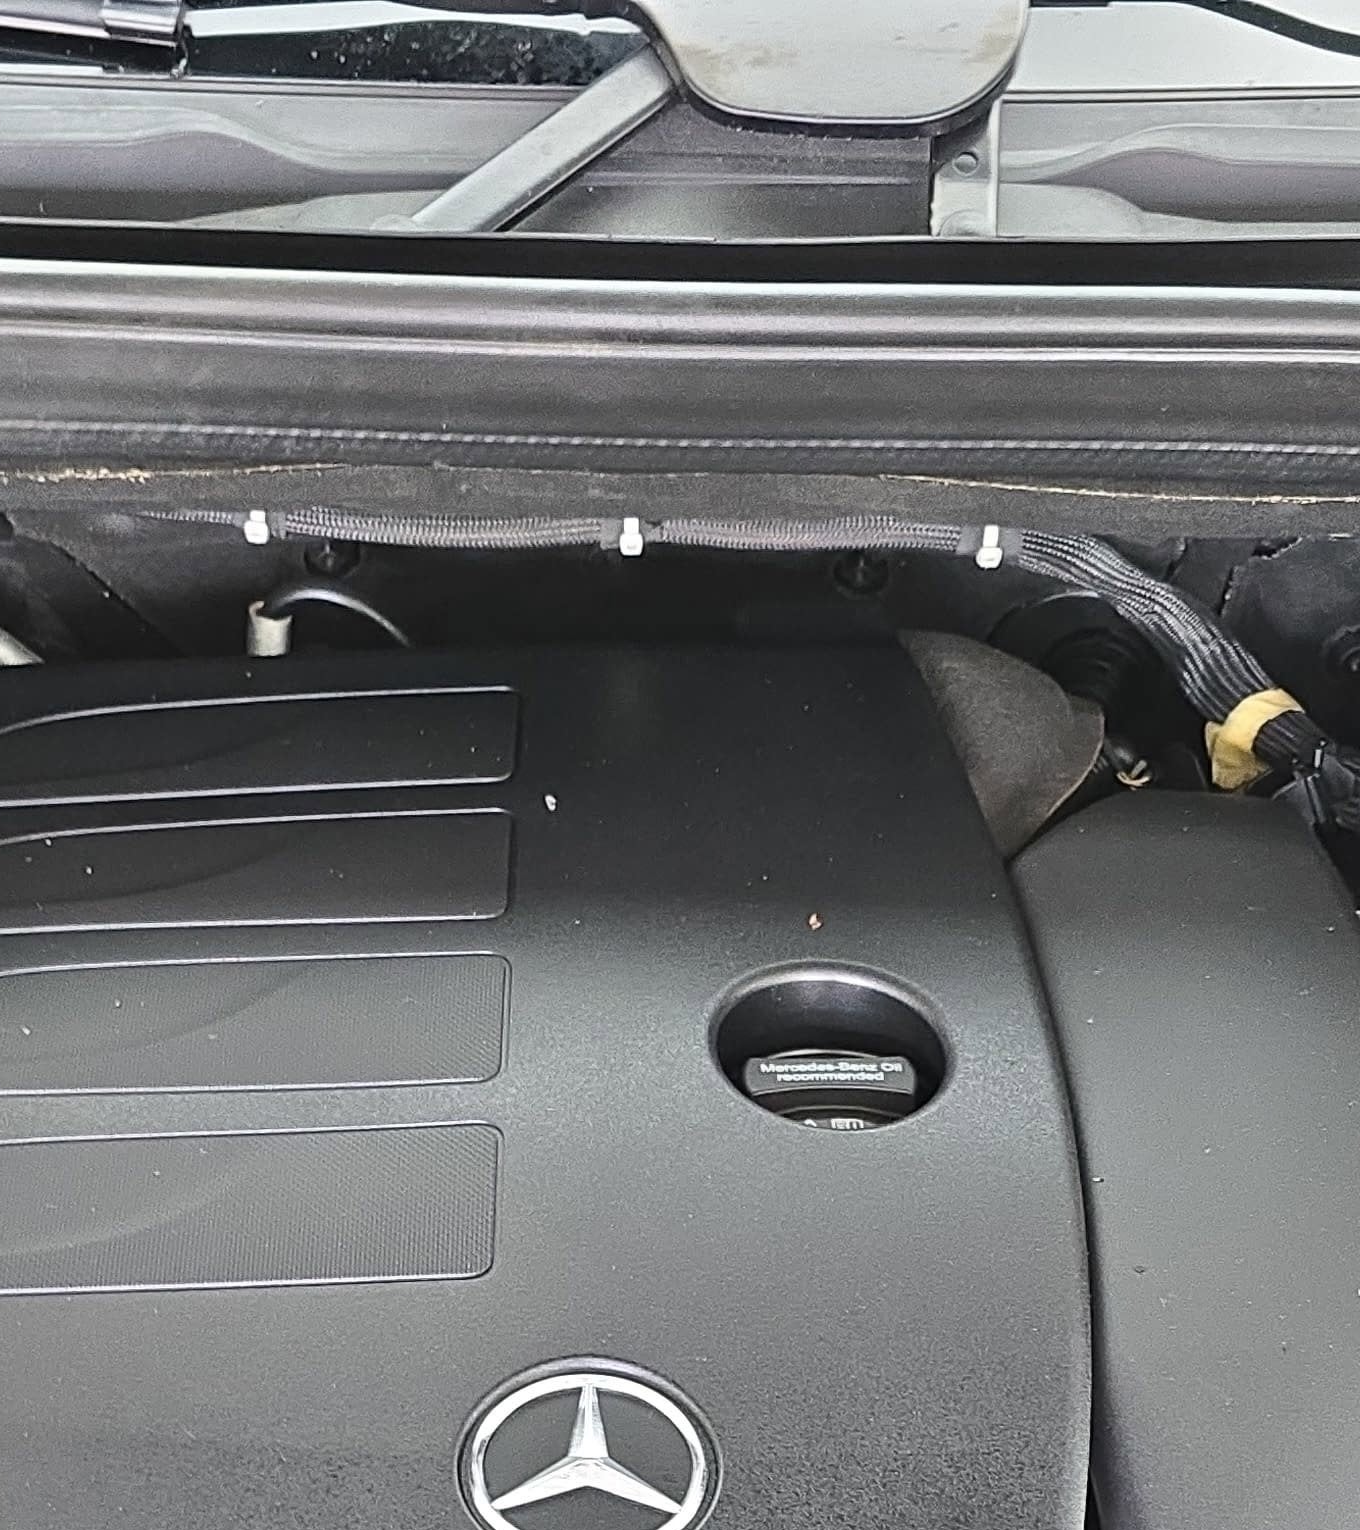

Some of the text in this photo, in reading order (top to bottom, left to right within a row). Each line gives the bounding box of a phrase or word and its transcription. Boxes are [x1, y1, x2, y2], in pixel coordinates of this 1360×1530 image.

[760, 1062, 902, 1073] Mercedes-Benz Oil
[777, 1072, 884, 1082] recommended
